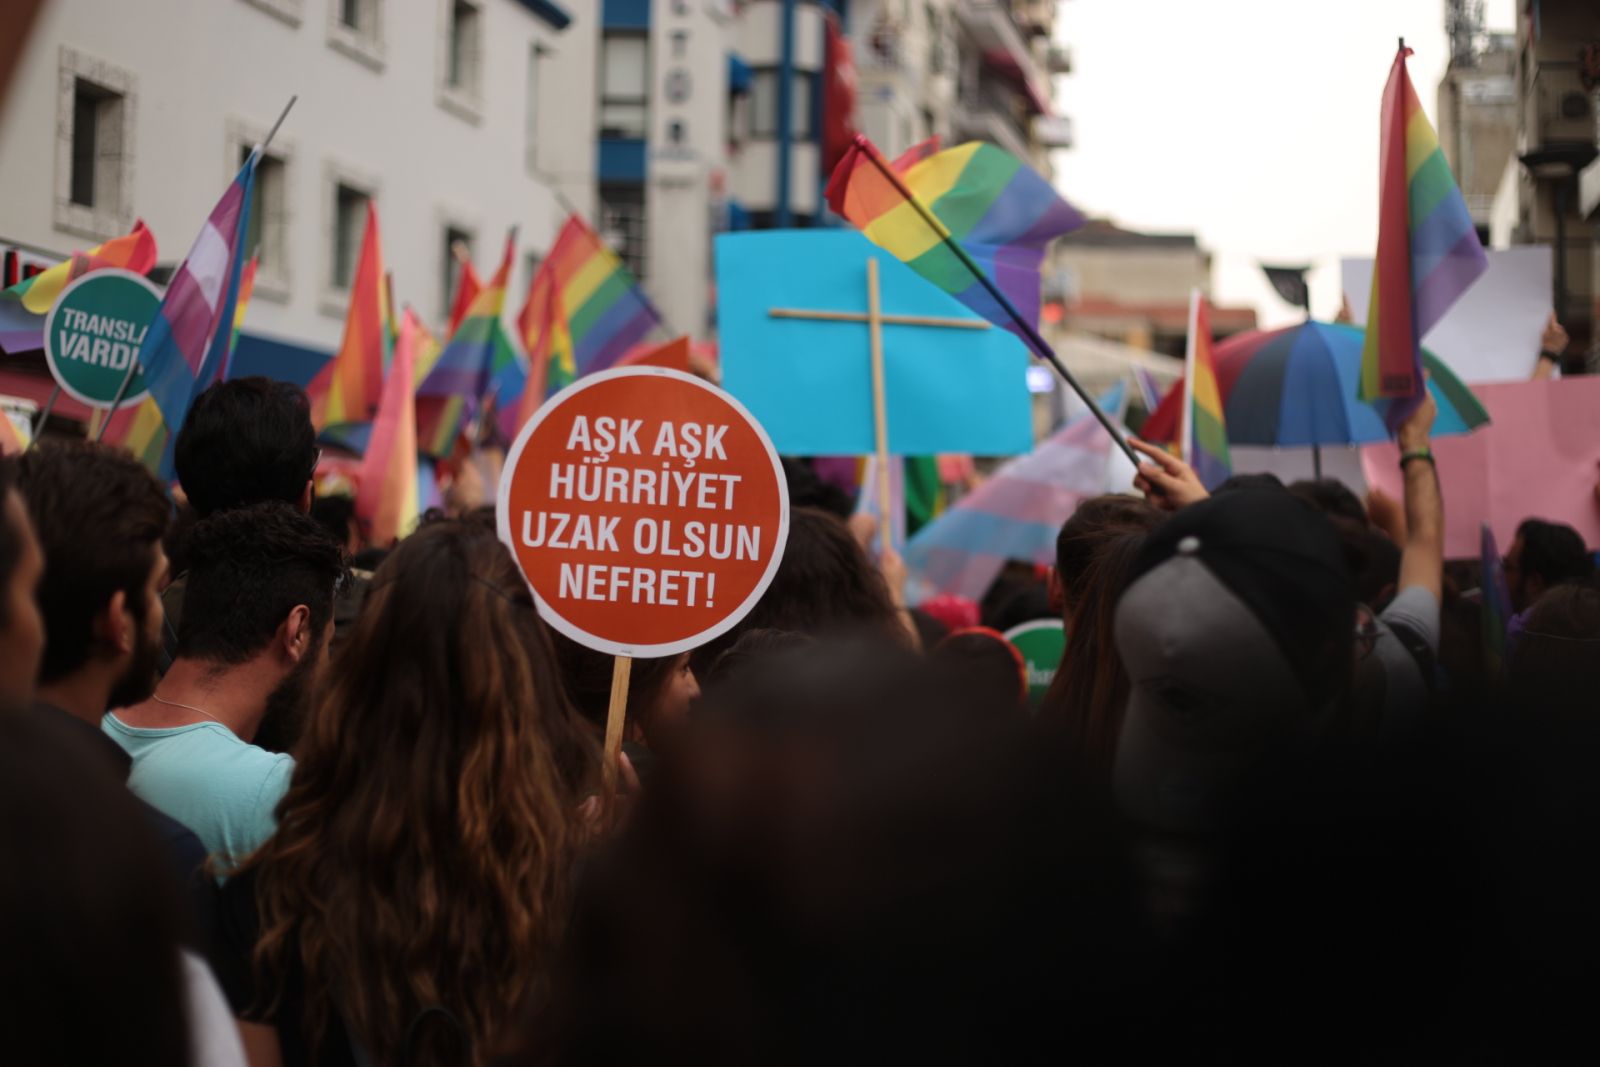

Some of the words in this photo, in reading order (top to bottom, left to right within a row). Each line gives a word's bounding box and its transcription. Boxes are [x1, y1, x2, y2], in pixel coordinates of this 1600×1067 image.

[566, 415, 643, 463] AŞK
[652, 421, 729, 468] AŞK
[549, 456, 742, 510] HÜRRİYET
[521, 510, 621, 552] UZAK
[633, 517, 761, 561] OLSUN
[558, 562, 716, 608] NEFRET!
